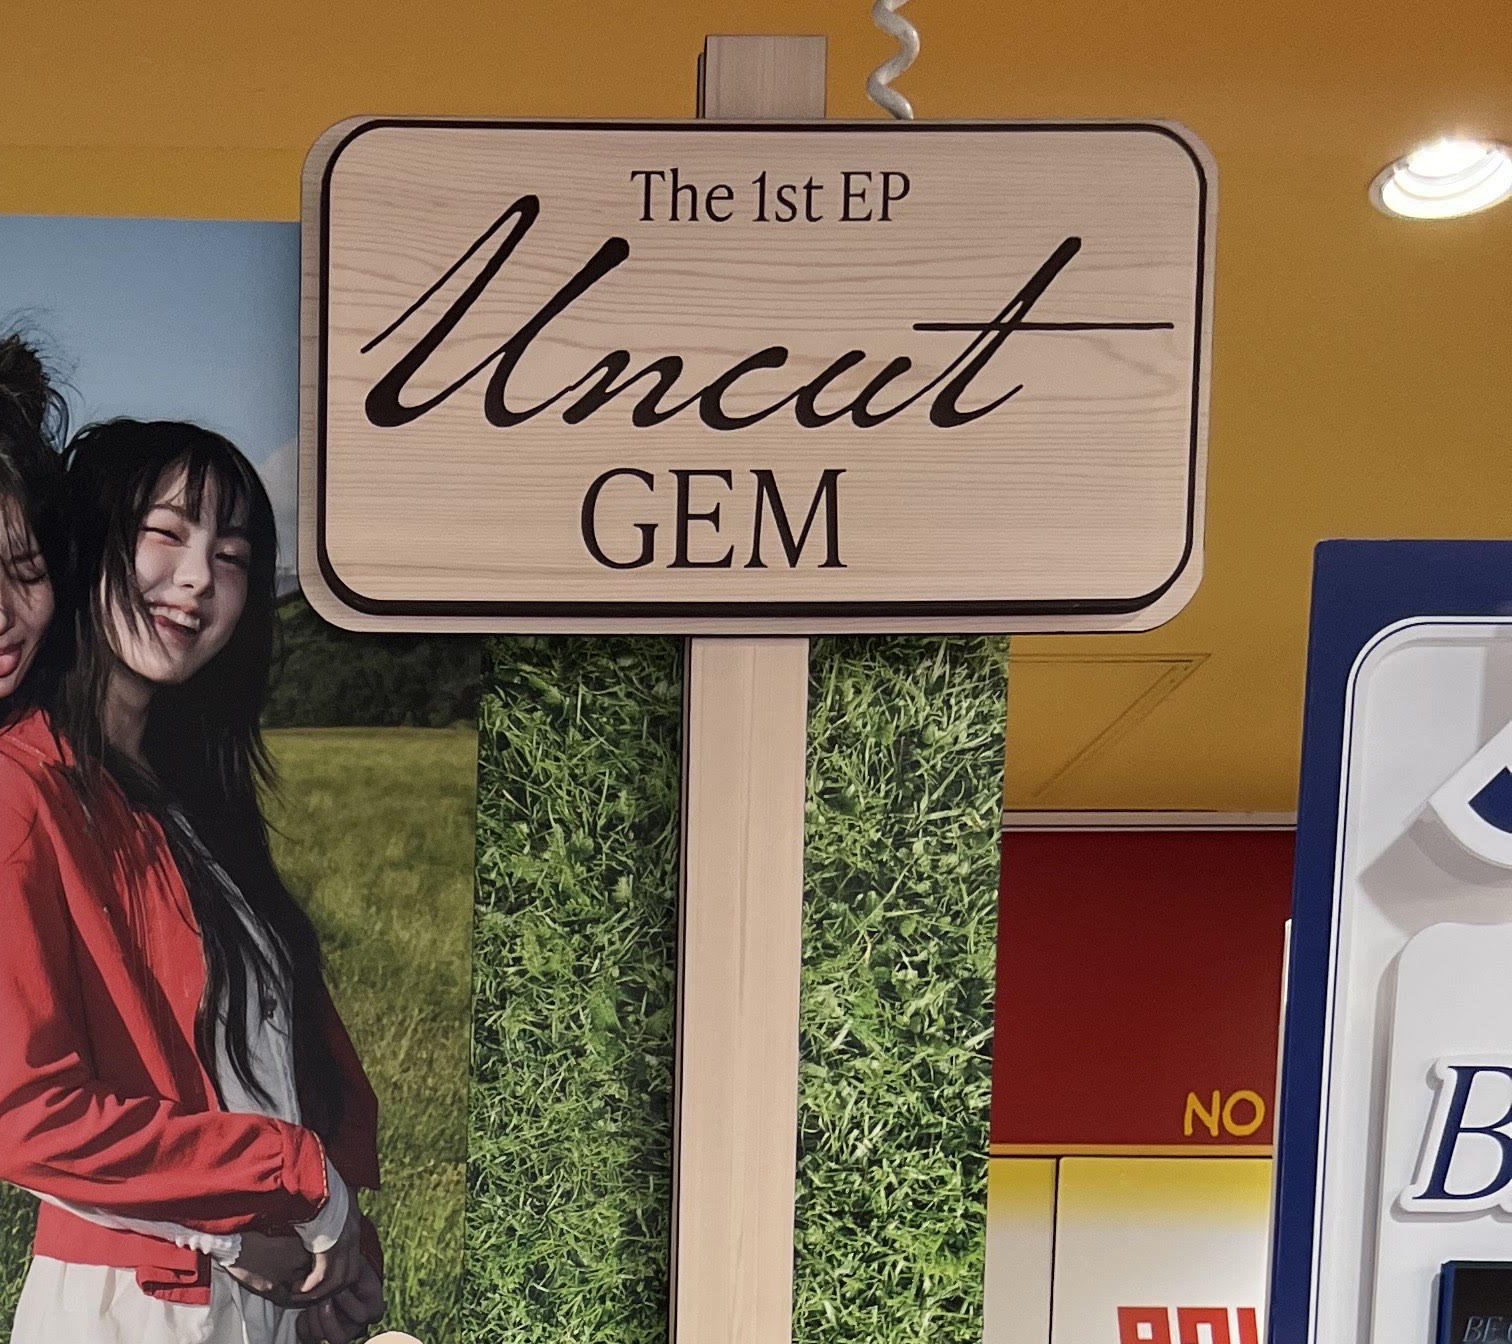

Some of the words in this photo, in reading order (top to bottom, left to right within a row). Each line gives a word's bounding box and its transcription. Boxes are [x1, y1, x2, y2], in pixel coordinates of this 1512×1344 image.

[631, 169, 735, 223] The
[752, 169, 823, 223] 1st
[839, 171, 911, 223] EP
[361, 194, 1175, 430] Uncut
[581, 467, 848, 570] GEM
[1184, 1090, 1265, 1136] NO
